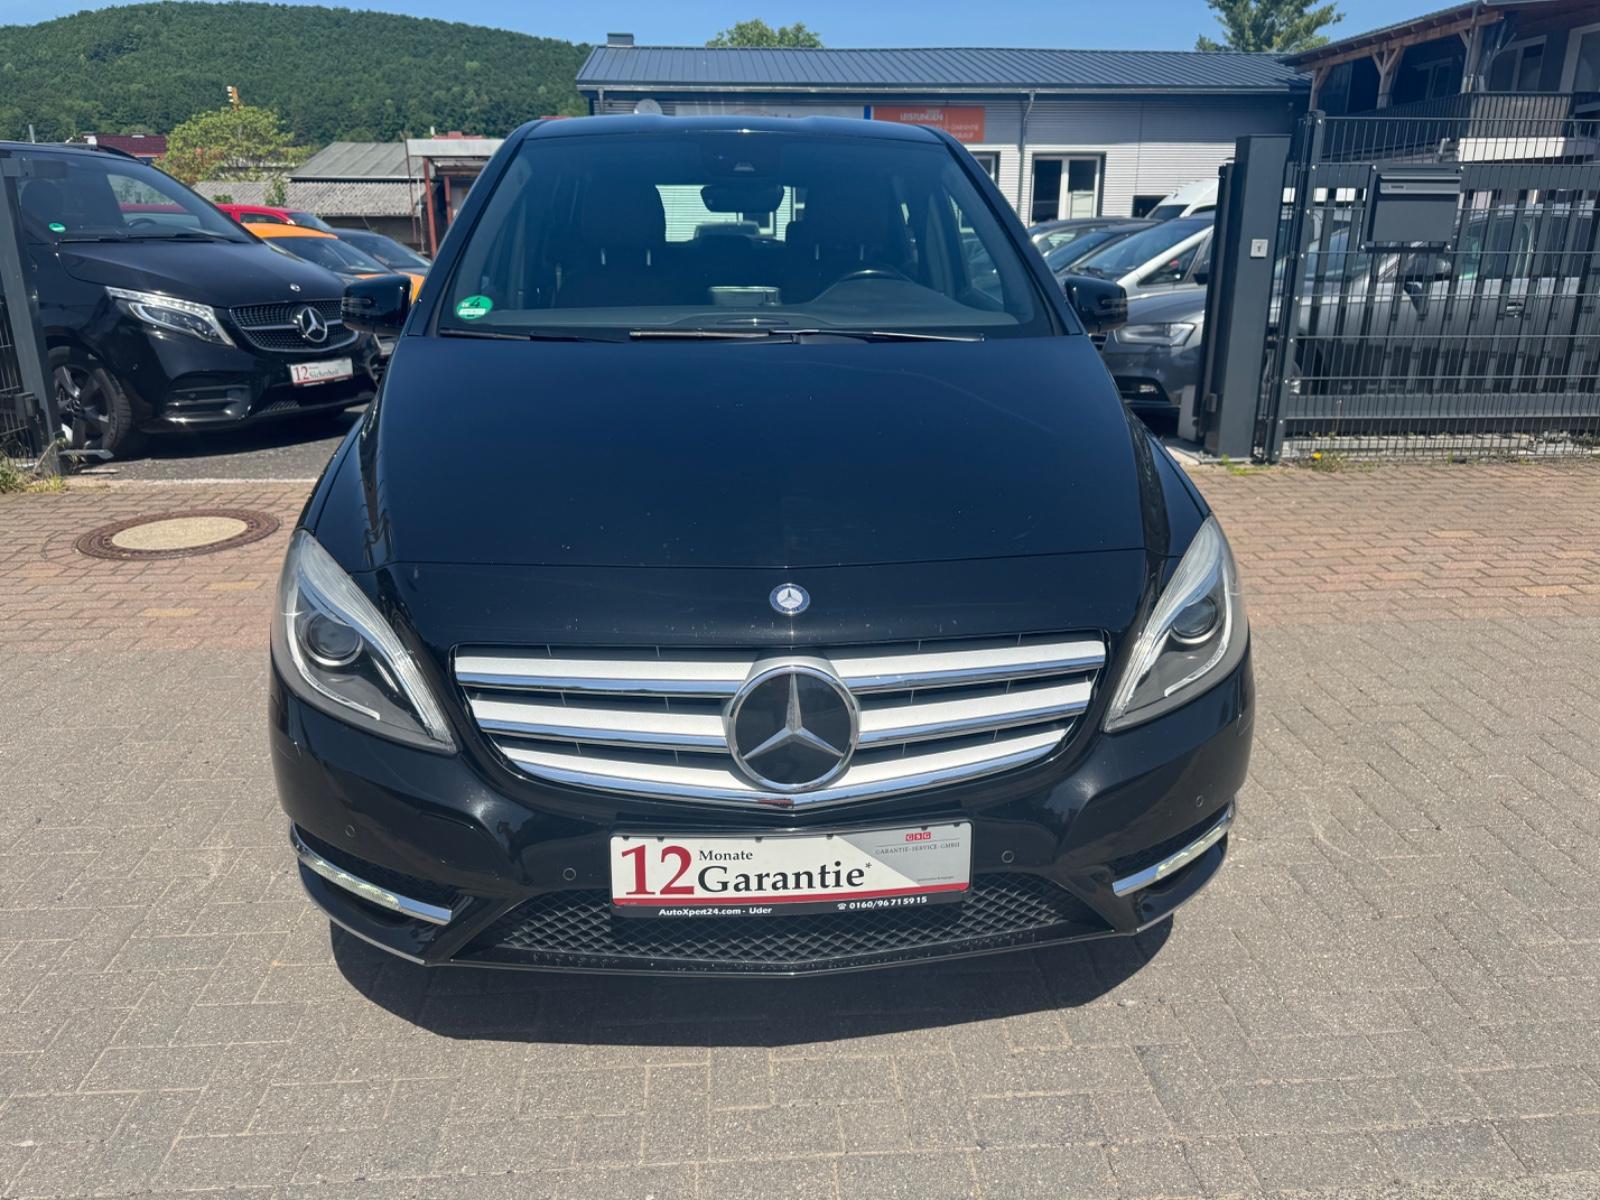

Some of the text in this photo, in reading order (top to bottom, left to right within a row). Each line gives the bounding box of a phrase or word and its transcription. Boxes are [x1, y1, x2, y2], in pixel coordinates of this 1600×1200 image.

[470, 296, 481, 308] 4
[293, 365, 310, 381] 12
[698, 849, 753, 862] Monate
[621, 844, 695, 896] 12
[658, 907, 741, 918] AutoXpert24.com
[748, 906, 772, 915] Uder
